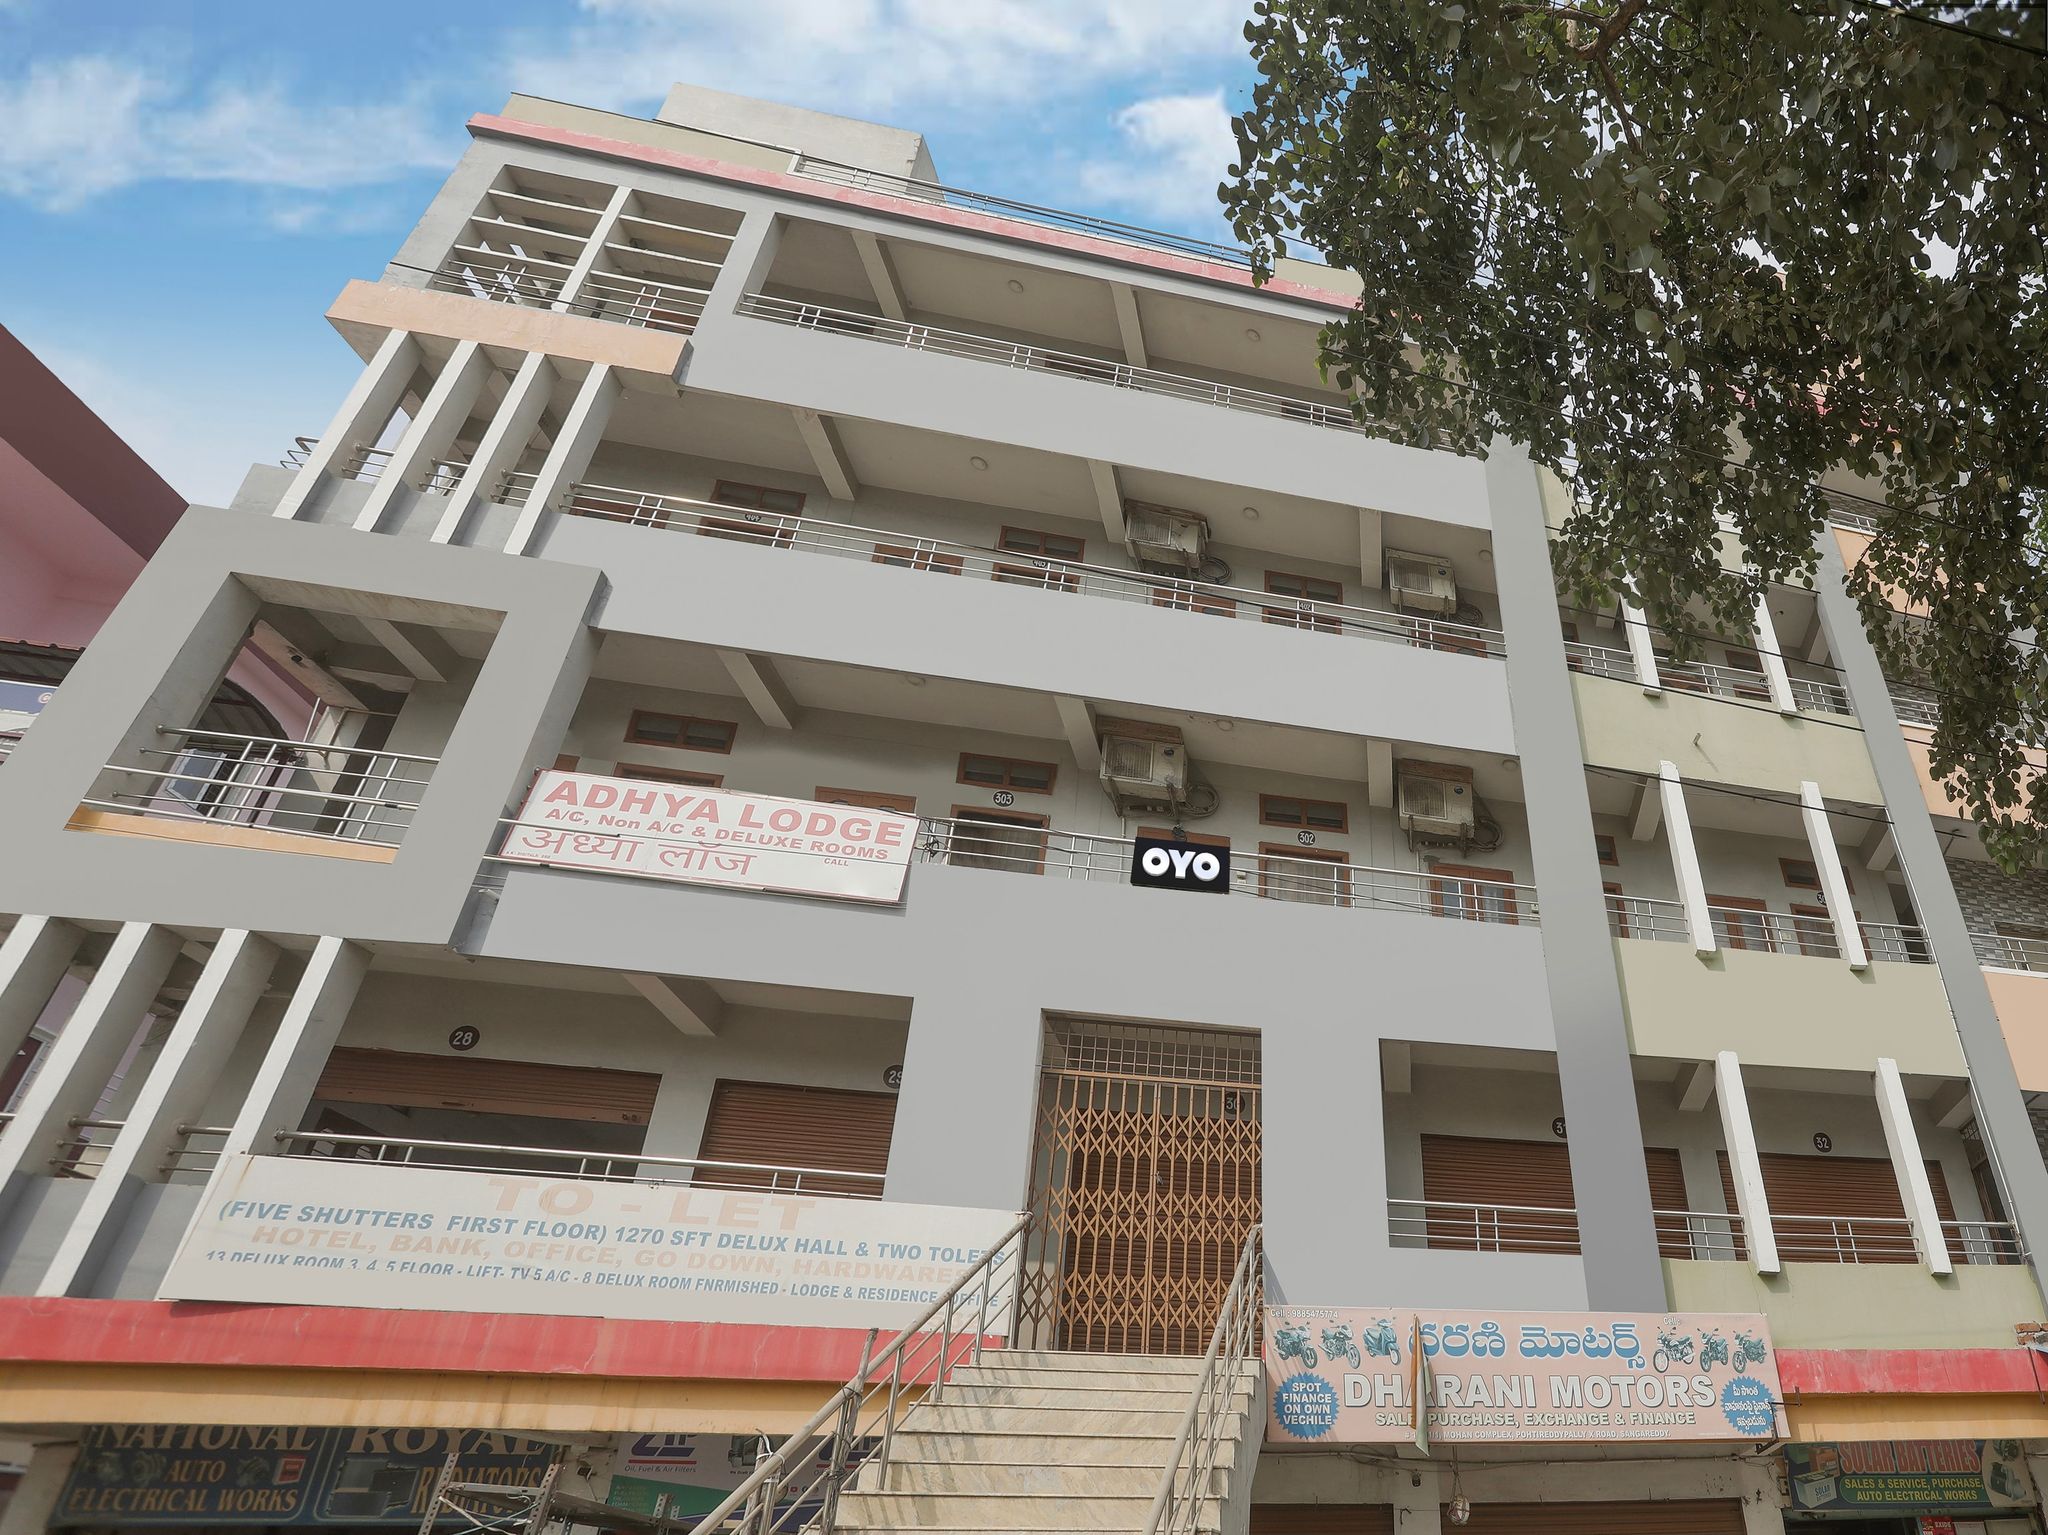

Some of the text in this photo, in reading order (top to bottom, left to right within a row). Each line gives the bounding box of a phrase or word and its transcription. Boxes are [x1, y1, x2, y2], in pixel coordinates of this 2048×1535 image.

[995, 792, 1014, 806] 303
[543, 780, 905, 847] ADHYA LODGE
[598, 814, 641, 829] Non
[647, 820, 684, 834] A/C
[692, 826, 706, 837] &
[715, 828, 802, 850] DELUXE
[810, 837, 889, 861] ROOMS
[1299, 832, 1315, 845] 302
[824, 857, 849, 868] CALL
[1142, 847, 1221, 882] OYO
[453, 1031, 473, 1046] 28
[1816, 1136, 1829, 1150] 32
[488, 1179, 594, 1216] TO
[668, 1190, 816, 1231] LET
[218, 1200, 291, 1221] (FIVE
[297, 1205, 434, 1230] SHUTTERS
[446, 1215, 519, 1235] FIRST
[523, 1221, 607, 1244] FLOOR)
[615, 1227, 664, 1244] 1270
[670, 1230, 712, 1248] SFT
[717, 1233, 788, 1253] DELUX
[795, 1238, 850, 1257] HALL
[855, 1243, 869, 1257] &
[878, 1244, 922, 1260] TWO
[251, 1225, 377, 1254] HOTEL,
[389, 1234, 491, 1260] BANK,
[504, 1240, 623, 1268] OFFICE,
[634, 1250, 678, 1268] GO
[688, 1253, 782, 1277] DOWN,
[400, 1262, 454, 1275] FLOOR
[511, 1267, 530, 1281] TV
[545, 1270, 571, 1283] A/C
[582, 1272, 592, 1284] 8
[595, 1272, 645, 1288] DELUX
[648, 1275, 692, 1291] ROOM
[695, 1278, 779, 1295] FNRMISHED
[791, 1283, 839, 1298] LODGE
[843, 1286, 853, 1299] &
[858, 1286, 938, 1303] RESIDENCE
[1270, 1309, 1285, 1317] Cell
[1292, 1382, 1321, 1392] SPOT
[1548, 1374, 1716, 1408] MOTORS
[1282, 1393, 1332, 1403] FINANCE
[1284, 1404, 1330, 1414] ON OWN
[1283, 1415, 1332, 1425] VECHILE
[1427, 1412, 1520, 1428] PURCHASE,
[1524, 1412, 1609, 1426] EXCHANGE
[1614, 1412, 1626, 1425] &
[1630, 1412, 1696, 1425] FINANCE
[95, 1424, 317, 1450] NATIONAL
[1839, 1441, 1980, 1473] SOLAR BATTERIES
[165, 1459, 227, 1483] AUTO
[411, 1466, 543, 1514] RDIATORS
[1845, 1478, 1984, 1490] SALES & SERVICE, PURCHASE,
[67, 1487, 298, 1512] ELECTRICAL WORKS
[1857, 1490, 1978, 1501] AUTO ELECTRICAL WORKS
